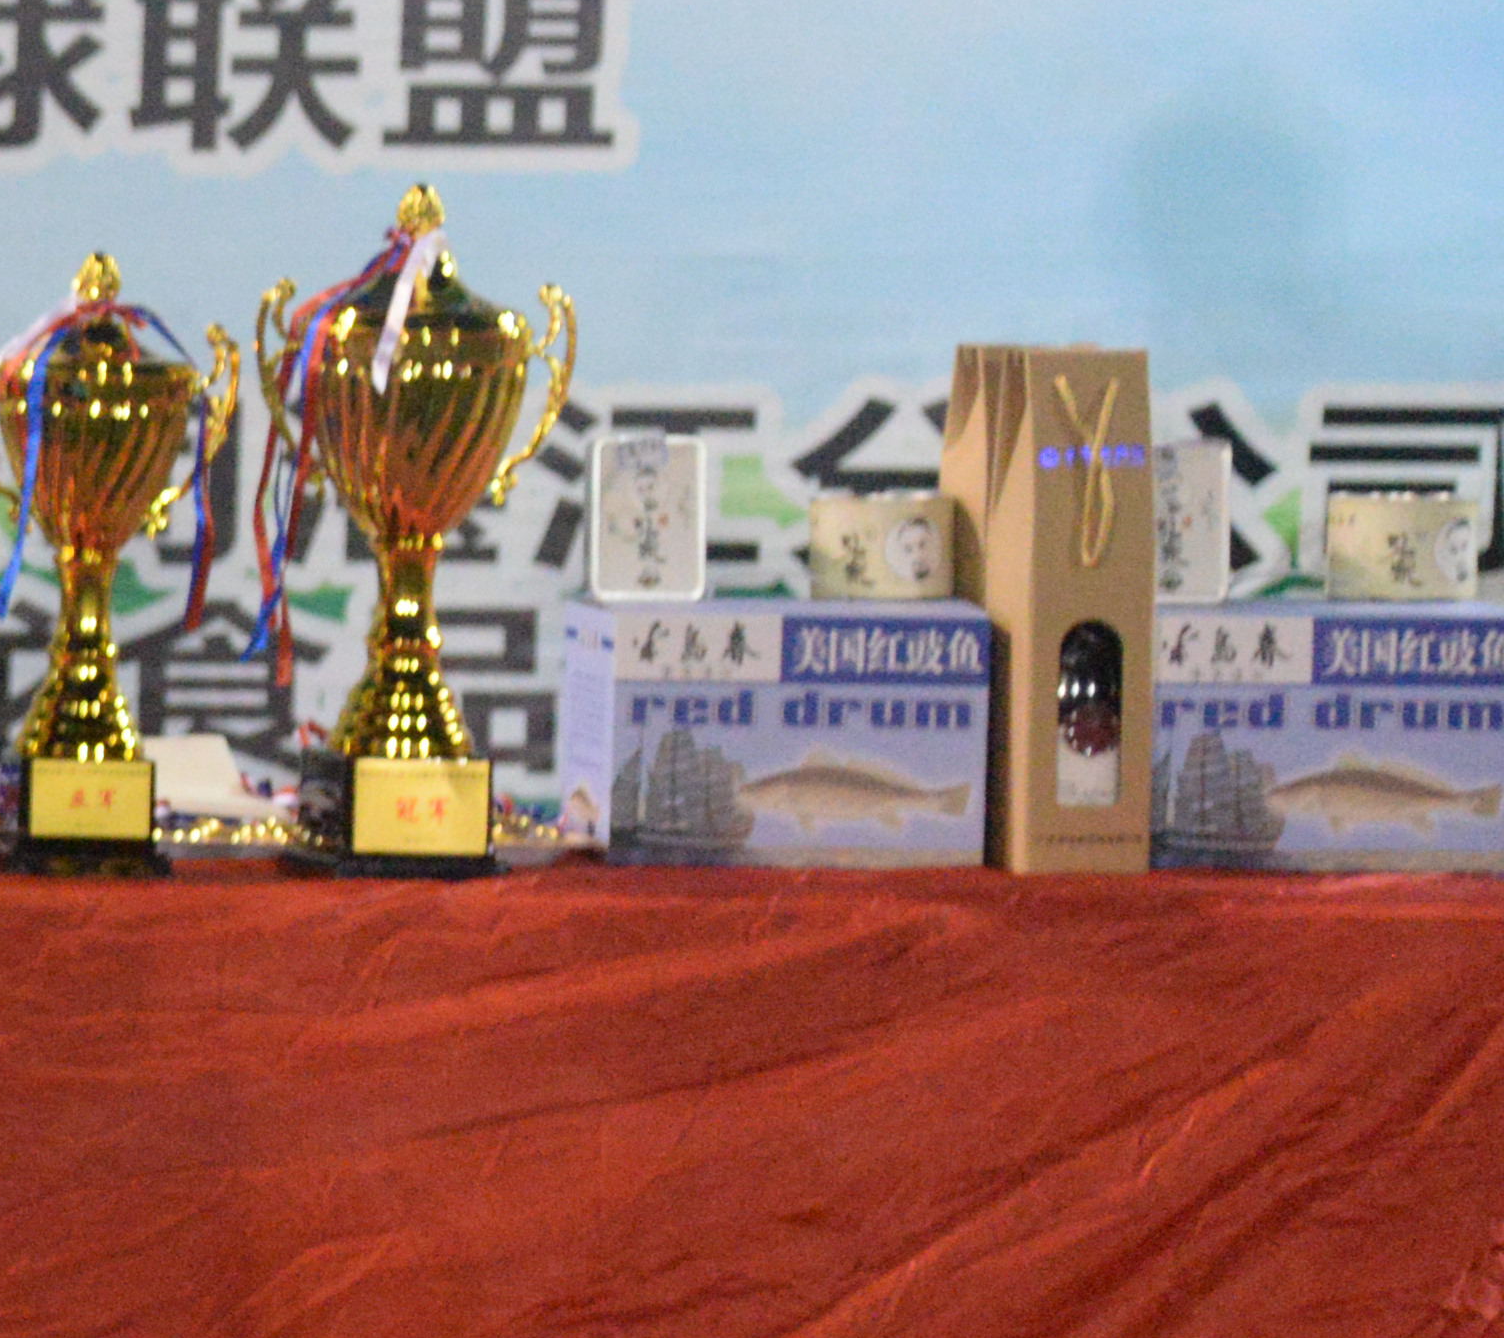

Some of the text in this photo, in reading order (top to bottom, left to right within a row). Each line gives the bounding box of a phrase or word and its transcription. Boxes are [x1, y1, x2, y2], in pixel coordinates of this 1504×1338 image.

[632, 691, 755, 725] red
[784, 693, 974, 729] drum
[1160, 693, 1504, 731] red drum
